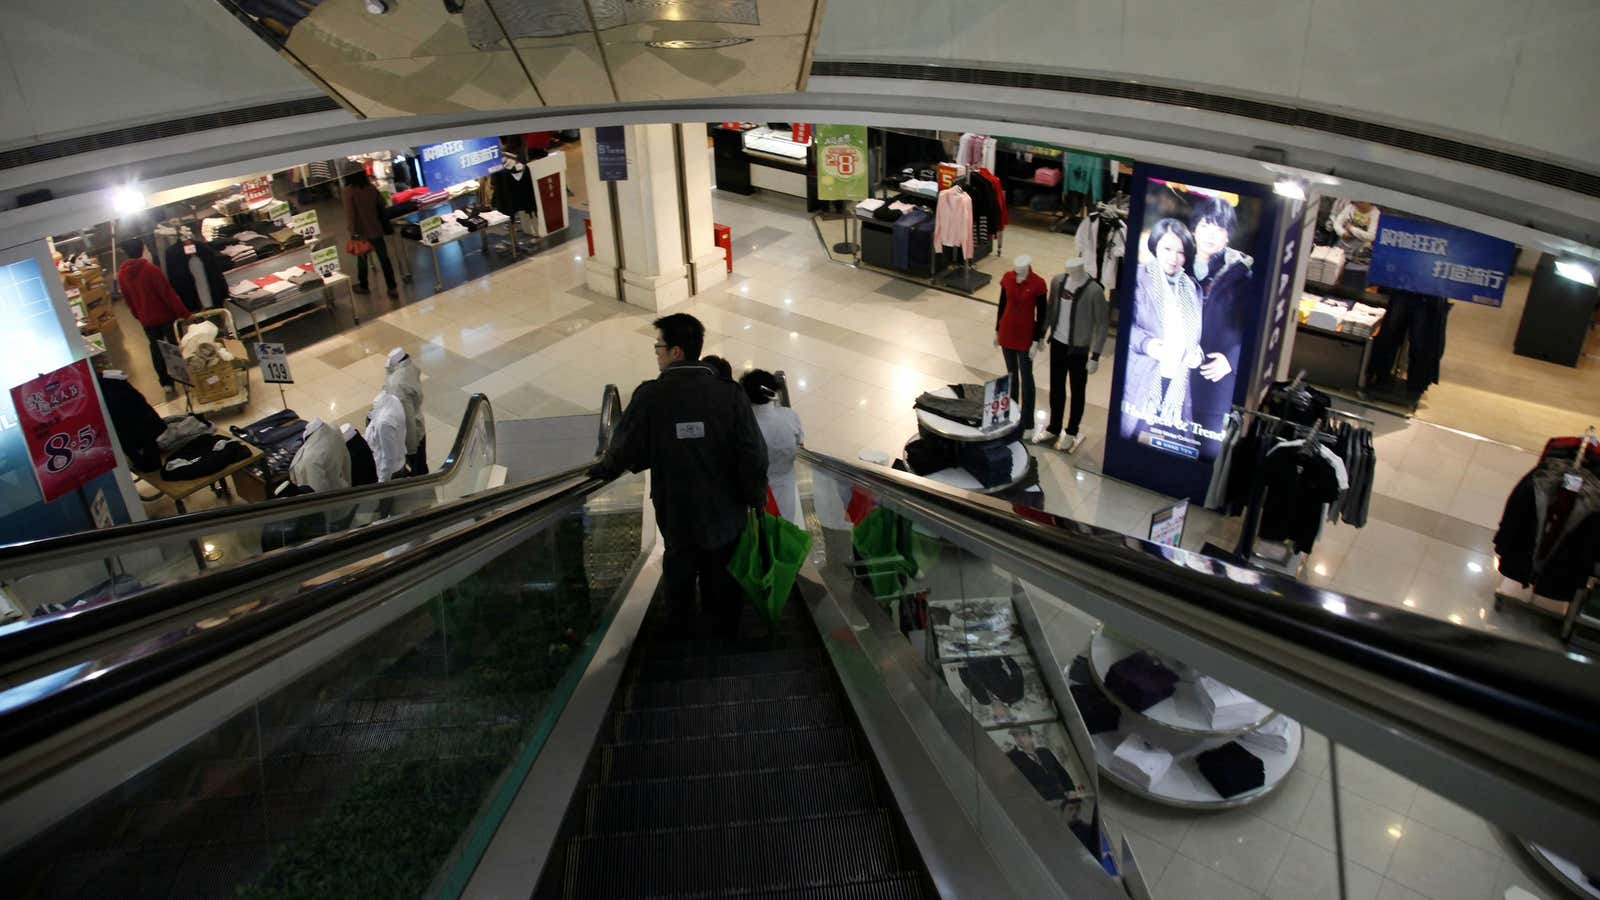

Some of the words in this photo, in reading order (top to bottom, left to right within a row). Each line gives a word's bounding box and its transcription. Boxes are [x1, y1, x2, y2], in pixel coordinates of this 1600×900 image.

[267, 363, 288, 379] 139
[991, 396, 1009, 415] 99
[1190, 421, 1227, 442] Trend
